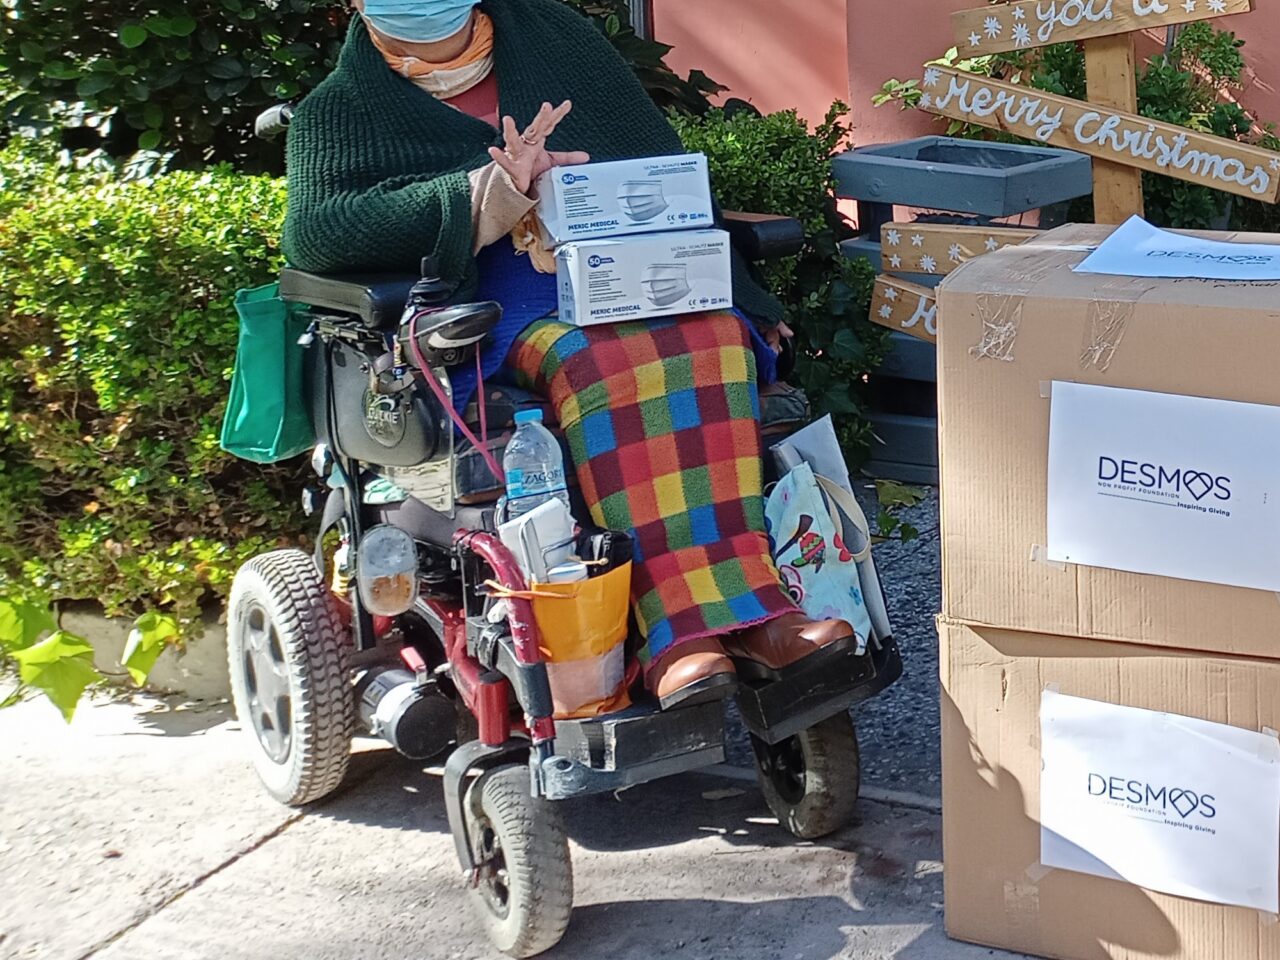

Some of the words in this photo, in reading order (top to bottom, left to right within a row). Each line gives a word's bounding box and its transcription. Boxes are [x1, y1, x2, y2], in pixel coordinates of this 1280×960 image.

[936, 76, 1064, 140] Merry
[1073, 111, 1270, 194] Christmas
[590, 220, 619, 228] MEDICAL
[612, 304, 641, 312] MEDICAL
[1138, 487, 1180, 499] FOUNDATION
[1177, 501, 1207, 513] Inspiring
[1208, 507, 1231, 517] Giving
